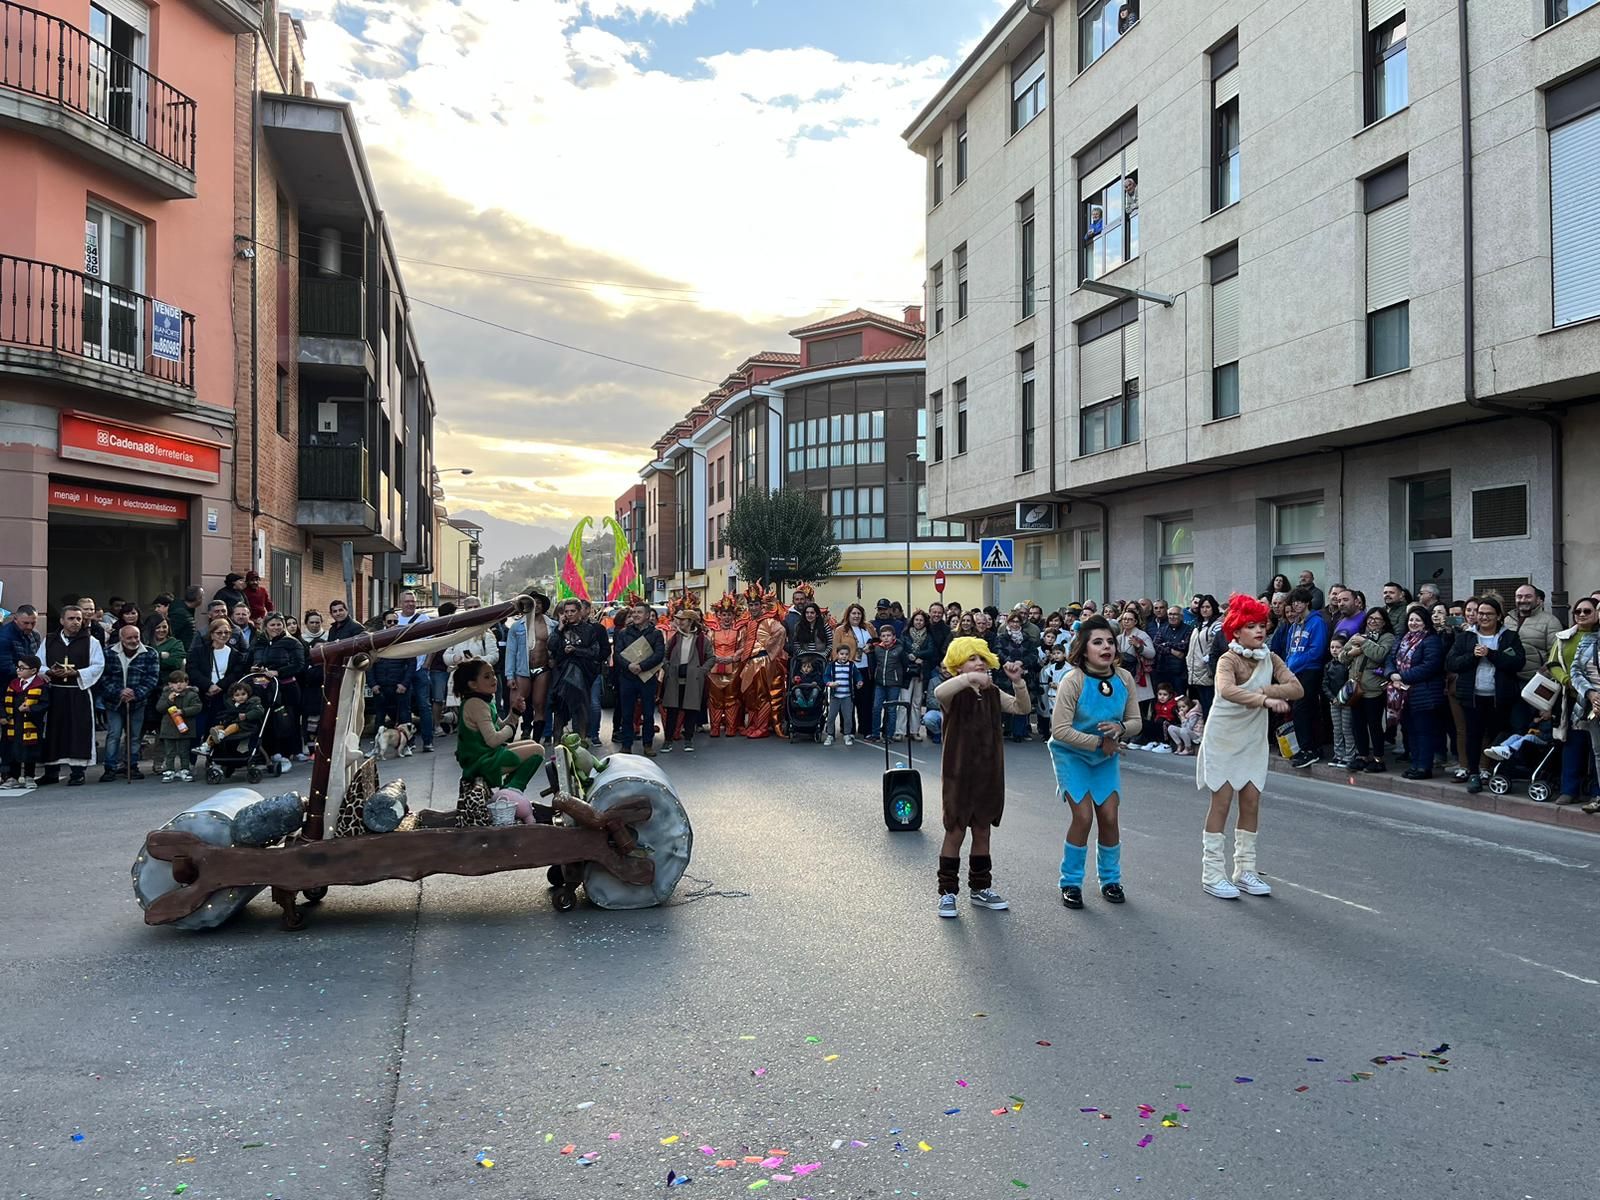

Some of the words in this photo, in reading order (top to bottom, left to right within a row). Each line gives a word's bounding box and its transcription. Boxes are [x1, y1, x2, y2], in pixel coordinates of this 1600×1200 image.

[86, 263, 98, 274] 66
[154, 302, 180, 319] VENDE
[155, 446, 194, 463] ferreterías
[54, 490, 80, 502] menaje
[94, 495, 113, 507] hogar
[123, 499, 177, 513] electrodomésticos
[922, 560, 972, 570] ALIMERKA
